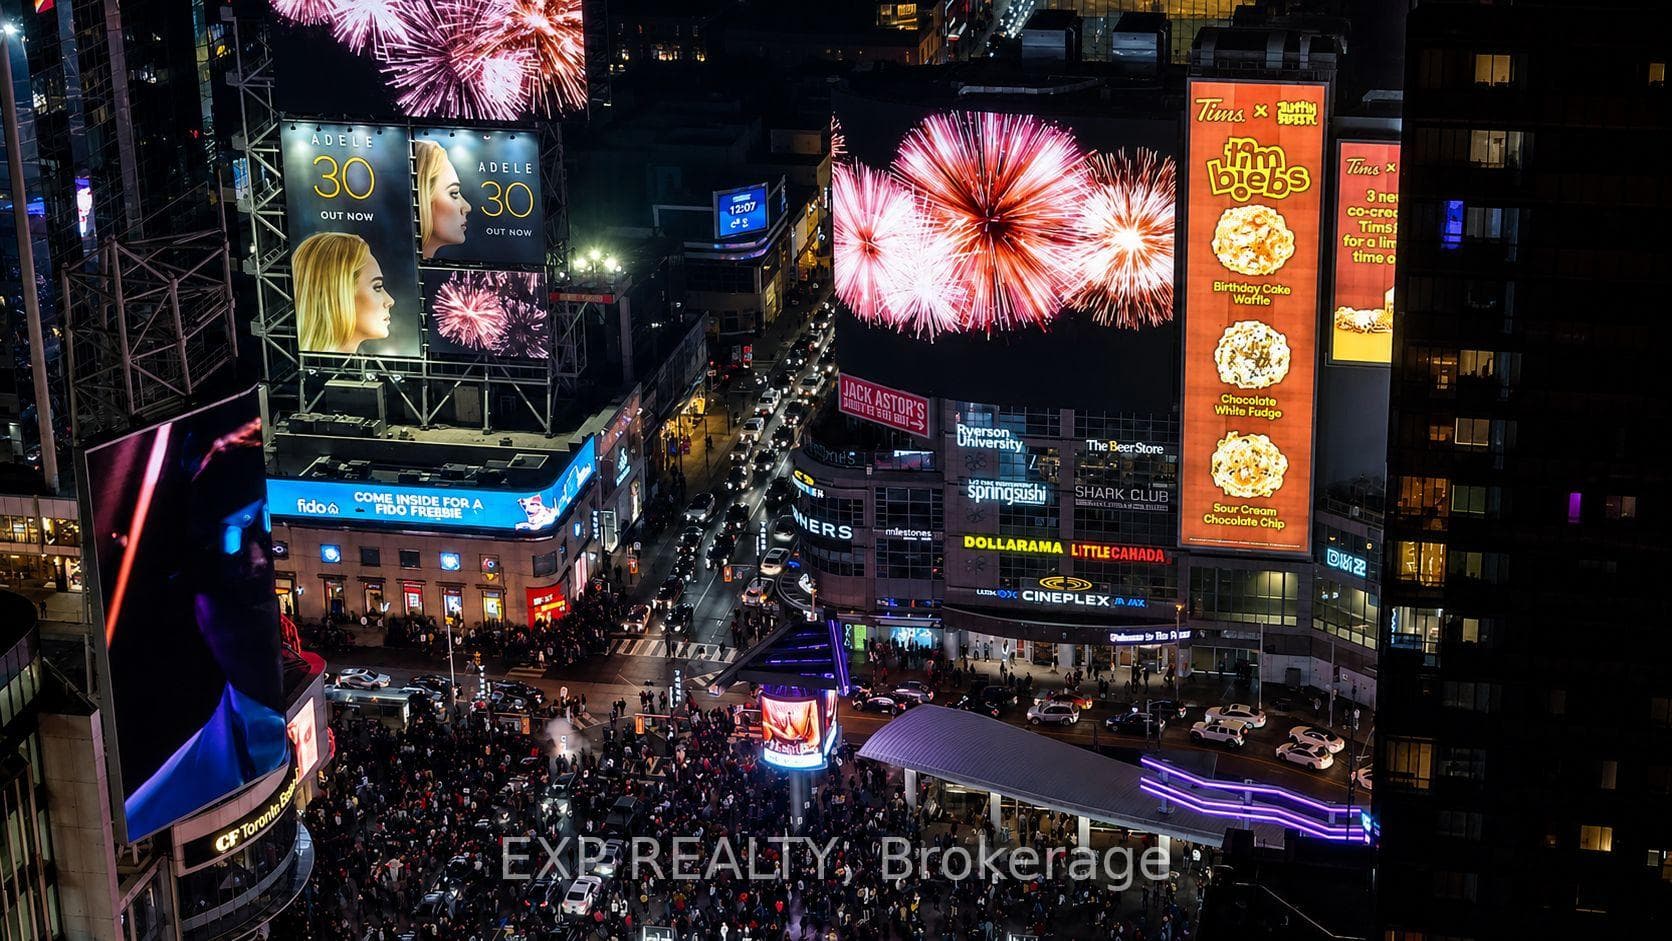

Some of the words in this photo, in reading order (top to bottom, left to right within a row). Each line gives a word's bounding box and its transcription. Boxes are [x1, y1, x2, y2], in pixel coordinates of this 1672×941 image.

[1196, 98, 1245, 122] Tims
[311, 133, 373, 148] ADELE
[479, 162, 533, 175] ADELE
[1346, 158, 1380, 176] Tims
[312, 155, 375, 200] 30
[480, 180, 534, 218] 30
[1366, 190, 1376, 202] 3
[320, 210, 343, 221] OUT
[347, 211, 374, 222] NOW
[730, 201, 756, 215] 12:07
[485, 227, 505, 237] OUT
[509, 228, 532, 238] NOW
[1343, 234, 1365, 247] for
[1366, 239, 1376, 248] a
[1352, 250, 1384, 264] time
[1213, 281, 1260, 296] Birthday
[1263, 284, 1291, 295] Cake
[1234, 294, 1271, 306] Waffle
[843, 380, 872, 405] JACK
[875, 390, 925, 420] ASTOR'S
[1221, 394, 1276, 406] Chocolate
[1215, 404, 1246, 417] White
[1248, 406, 1282, 420] Fudge
[957, 423, 1010, 440] Ryerson
[957, 433, 1023, 453] University
[1086, 440, 1108, 451] The
[1109, 440, 1135, 451] Beer
[1135, 442, 1164, 454] Store
[354, 491, 393, 504] COME
[396, 494, 440, 507] INSIDE
[442, 497, 469, 509] FOR
[473, 498, 484, 510] A
[1075, 485, 1125, 500] SHARK
[1130, 489, 1168, 502] CLUB
[297, 498, 327, 514] fido
[376, 503, 407, 516] FIDO
[410, 505, 463, 520] FREEBIE
[1213, 503, 1239, 514] Sour
[1241, 505, 1277, 516] Cream
[1204, 514, 1258, 527] Chocolate
[1260, 518, 1285, 530] Chip
[964, 535, 1063, 554] DOLLARAMA
[1022, 590, 1110, 606] CINEPLEX
[215, 829, 240, 852] CF
[240, 803, 281, 839] Toronto
